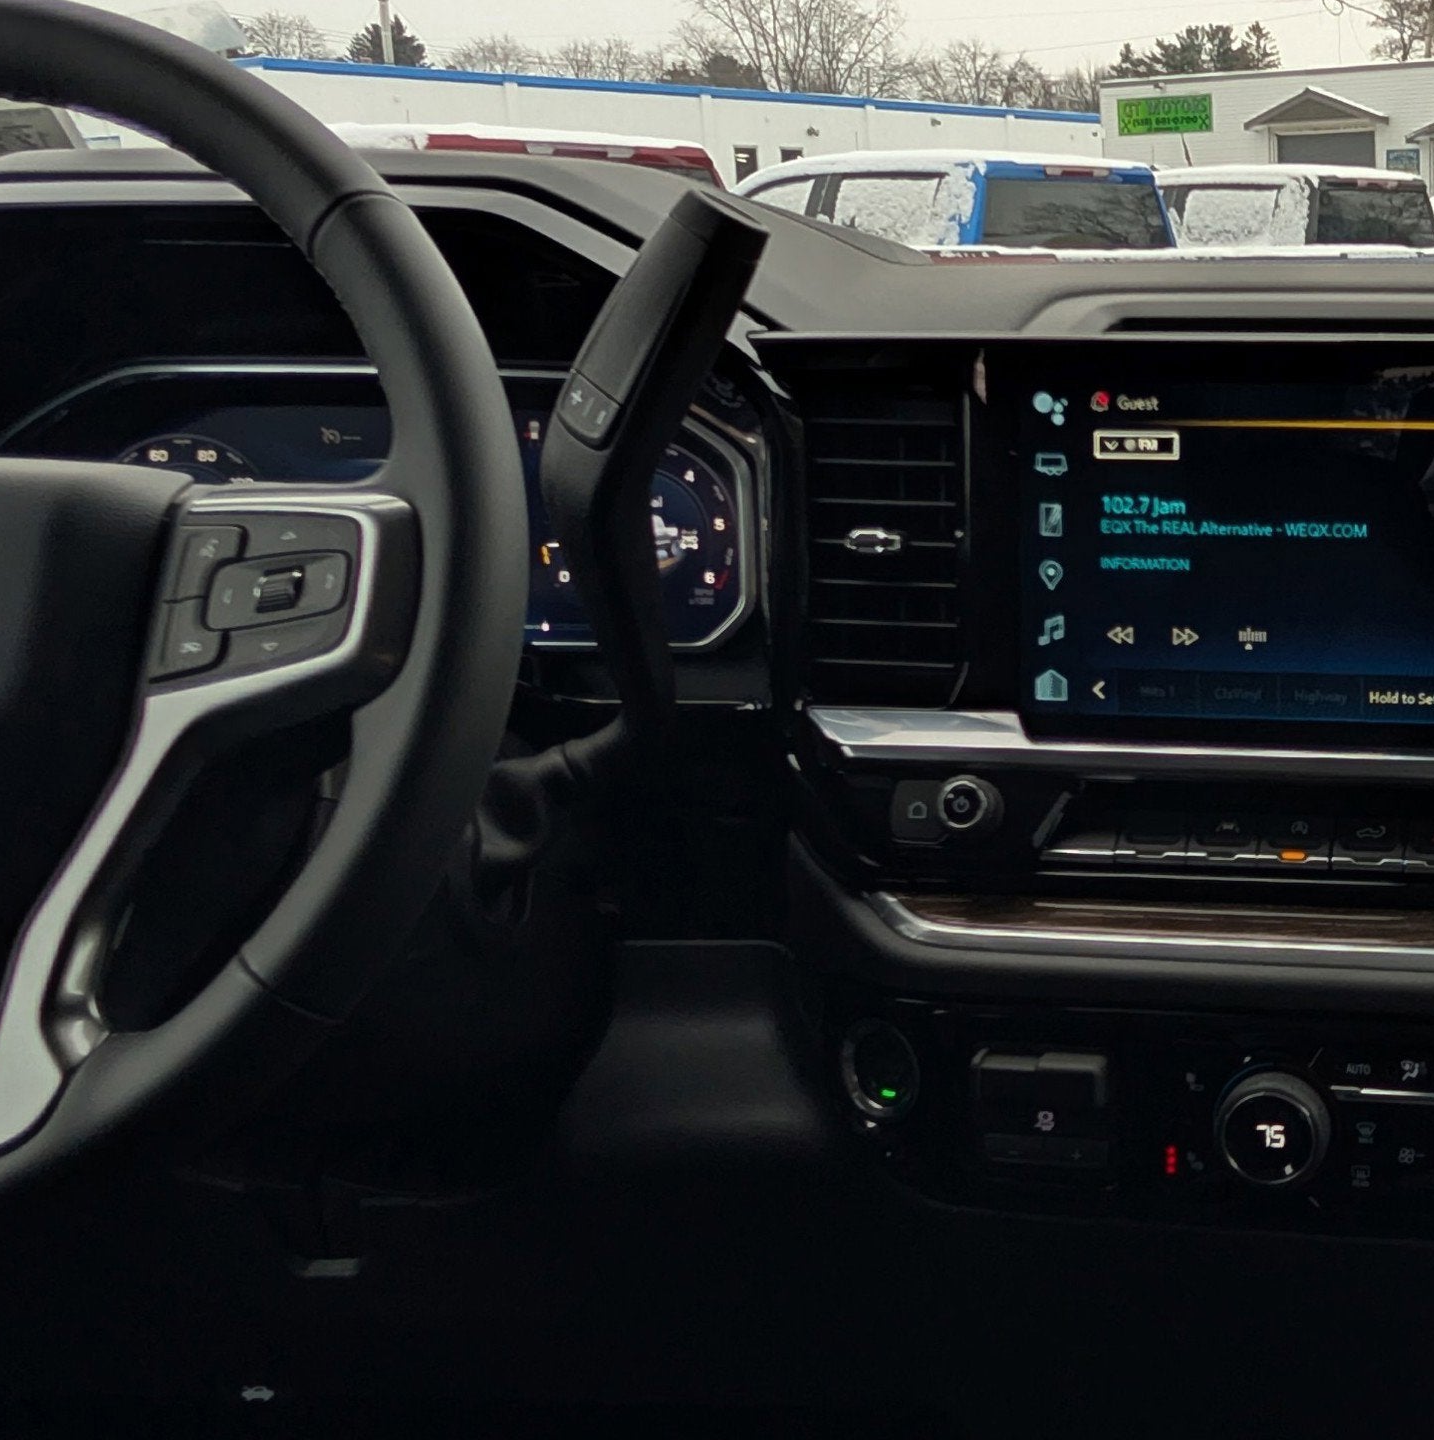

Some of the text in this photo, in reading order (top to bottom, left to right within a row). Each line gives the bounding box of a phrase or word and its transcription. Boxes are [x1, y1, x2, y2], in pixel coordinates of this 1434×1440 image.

[1116, 394, 1160, 412] Guest
[1138, 439, 1158, 451] FM
[683, 469, 696, 483] 4
[1101, 495, 1187, 518] 102.7 Jam
[712, 517, 726, 531] 5
[1100, 518, 1133, 534] EQX
[1134, 519, 1159, 534] The
[1161, 520, 1198, 535] REAL
[1199, 521, 1273, 537] Alternative
[1284, 522, 1369, 538] WEQX.COM
[1099, 556, 1191, 571] INFORMATION
[702, 569, 716, 585] 6
[1368, 691, 1399, 705] Hold
[1401, 692, 1416, 705] to
[1345, 1064, 1372, 1076] AUTO
